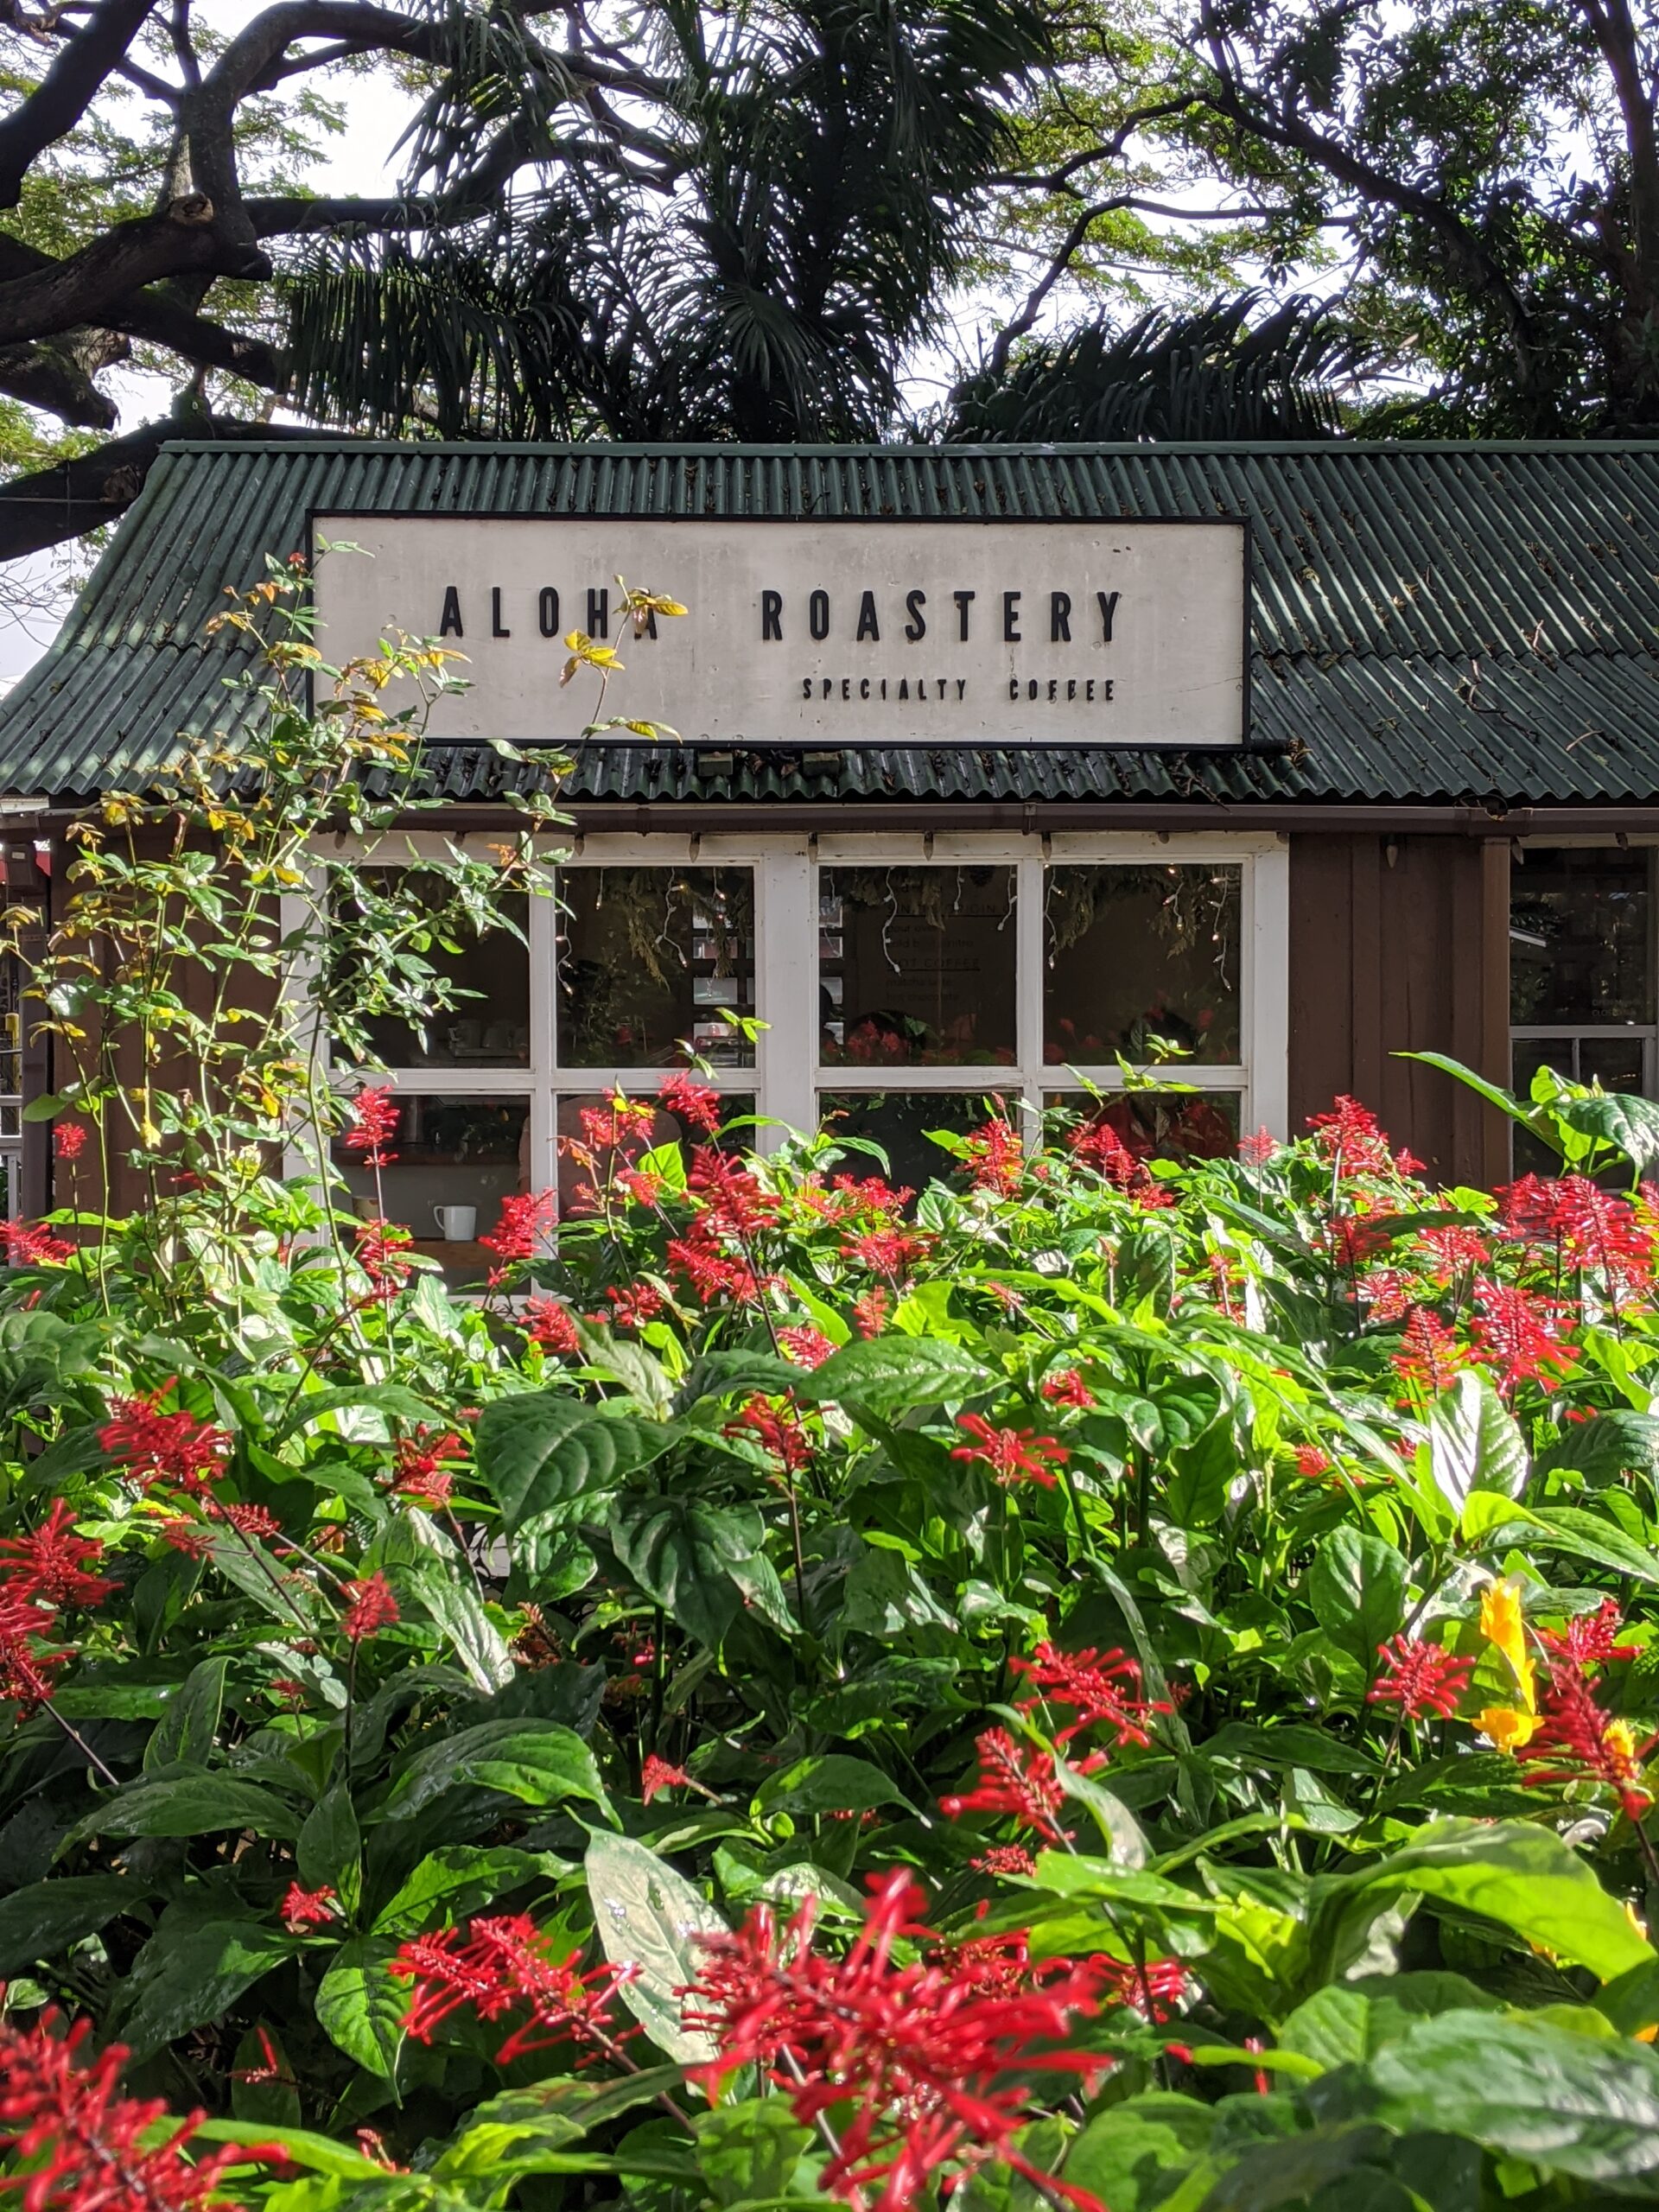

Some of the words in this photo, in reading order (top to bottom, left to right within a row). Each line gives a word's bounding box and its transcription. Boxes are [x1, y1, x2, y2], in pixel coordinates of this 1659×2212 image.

[762, 589, 1120, 642] ROASTERY
[803, 678, 966, 701] SPECIALTY
[1009, 678, 1114, 701] COFFEE
